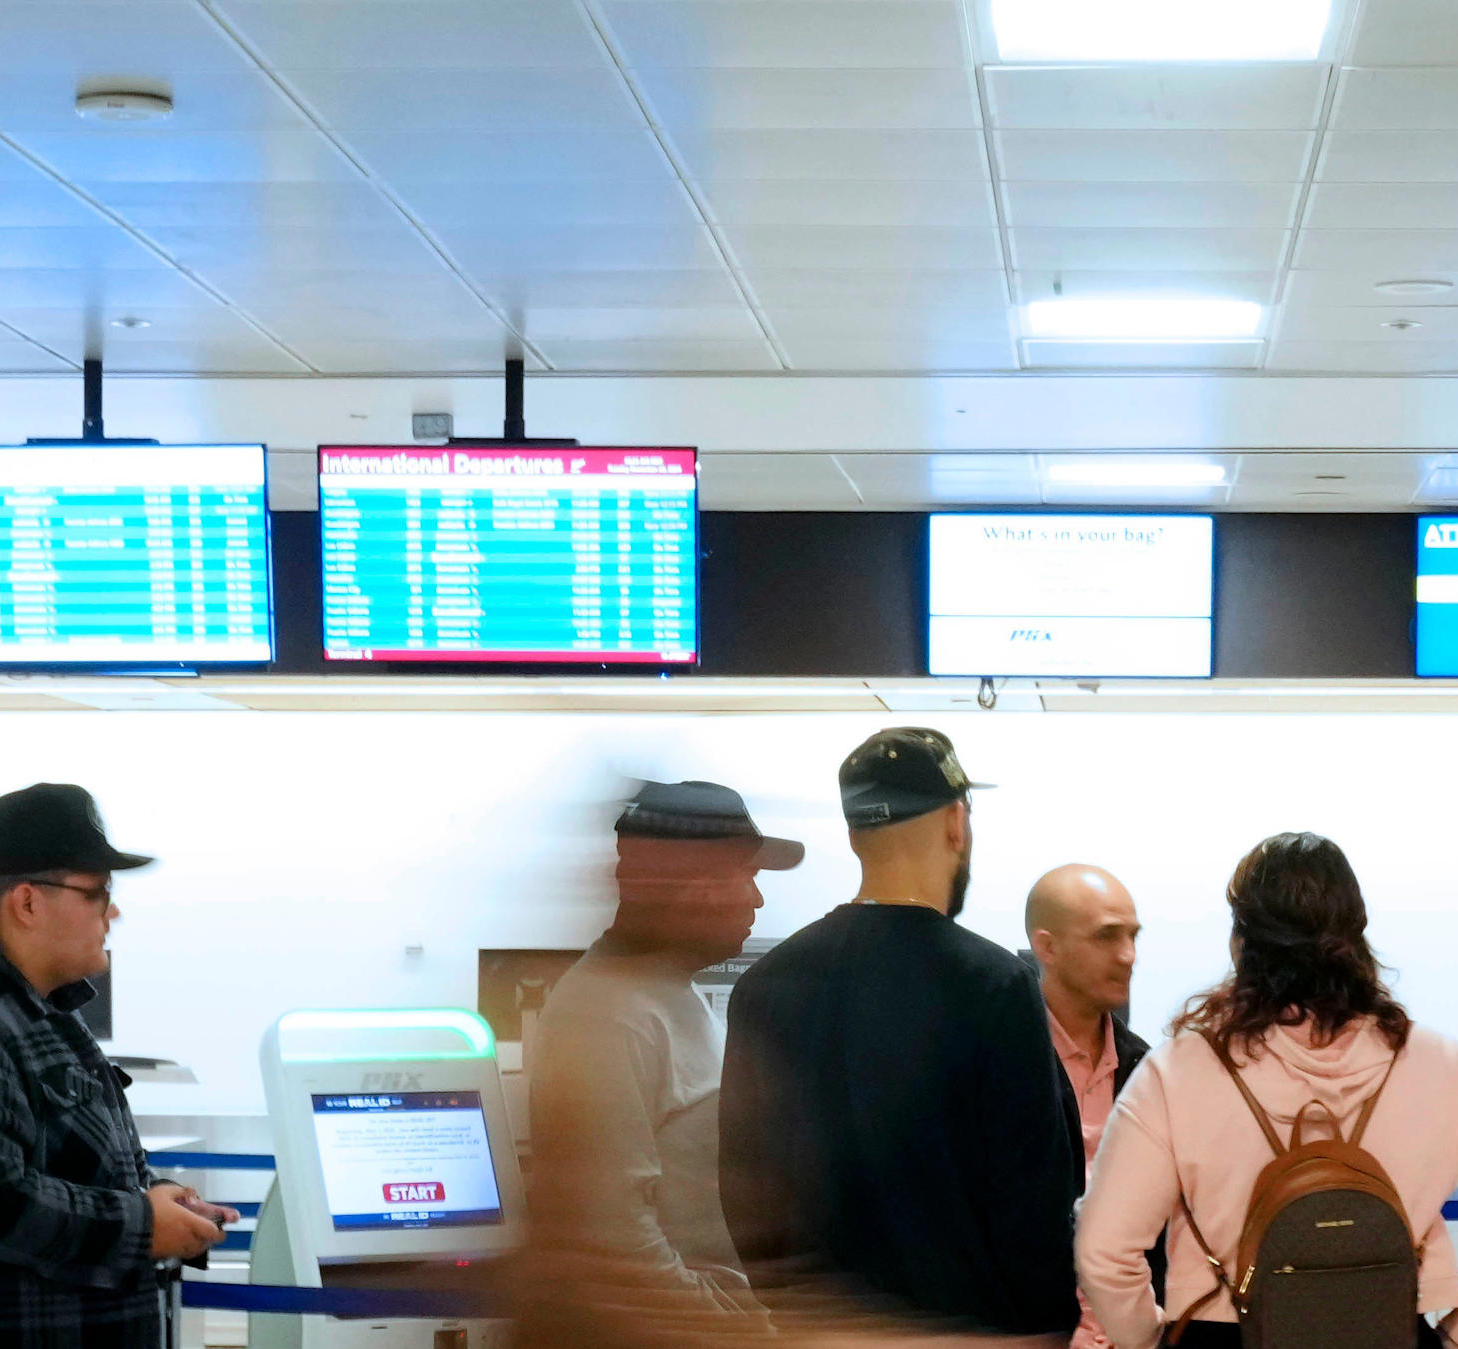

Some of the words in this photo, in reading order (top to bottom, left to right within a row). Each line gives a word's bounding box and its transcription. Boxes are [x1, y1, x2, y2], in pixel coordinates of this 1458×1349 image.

[322, 454, 449, 475] International
[453, 454, 564, 477] Departures
[1054, 526, 1071, 542] in
[1078, 529, 1117, 545] your
[1123, 526, 1165, 546] bag?
[390, 1185, 437, 1201] START
